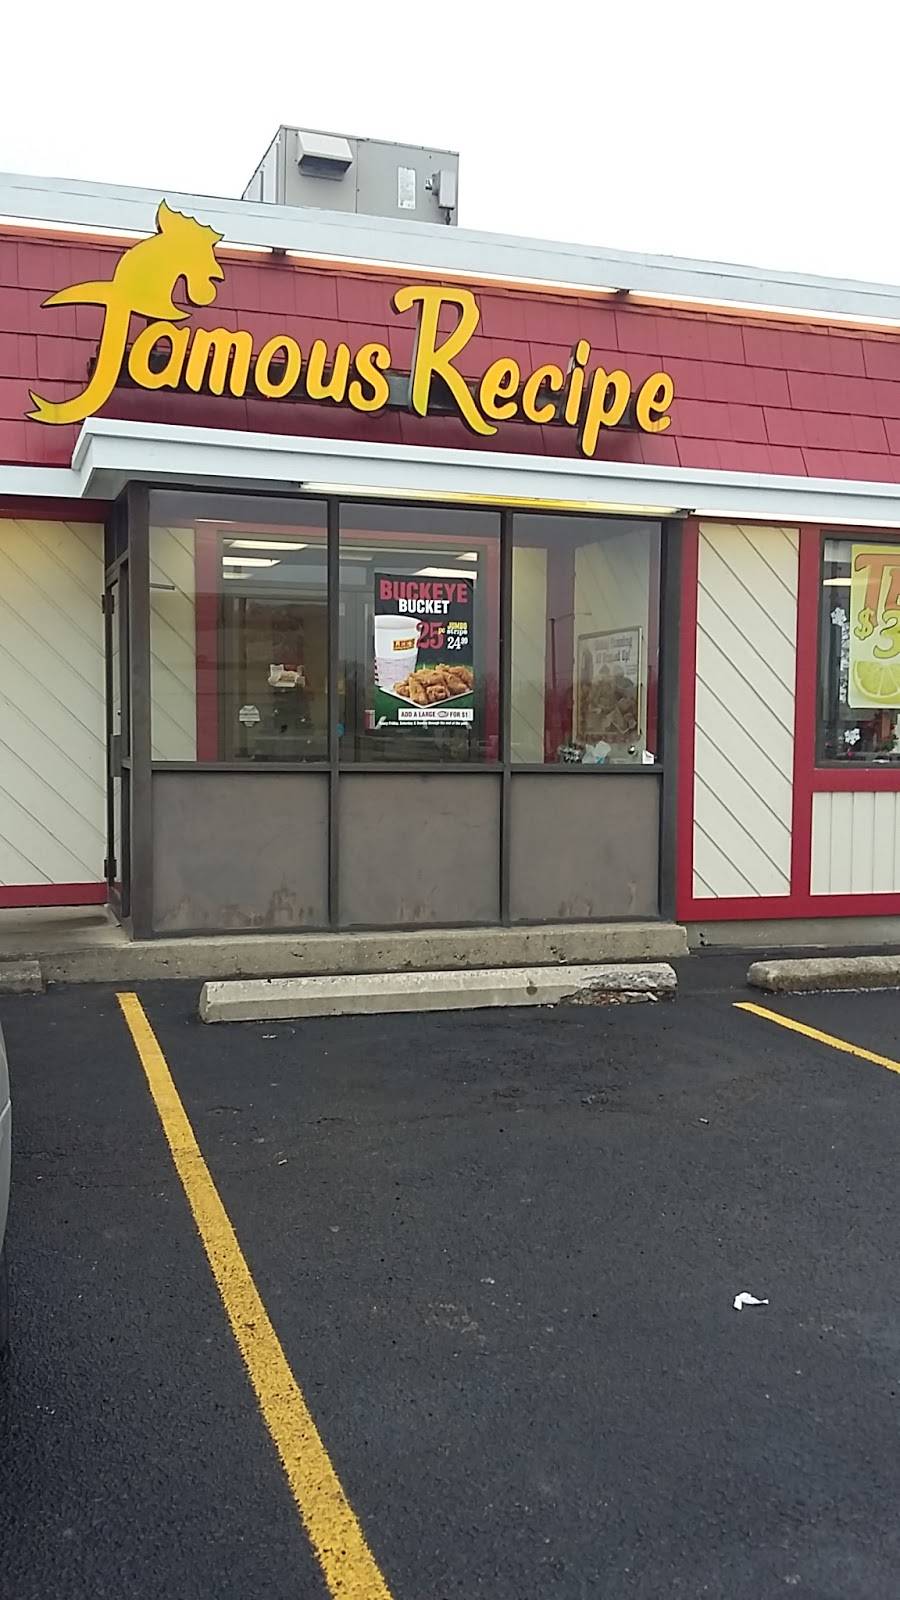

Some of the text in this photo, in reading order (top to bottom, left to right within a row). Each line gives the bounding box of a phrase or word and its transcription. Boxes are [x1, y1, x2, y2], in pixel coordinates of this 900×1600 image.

[26, 198, 675, 457] Famous Recipe
[379, 579, 468, 603] BUCKEYE
[398, 599, 450, 614] BUCKET
[416, 621, 444, 649] 25
